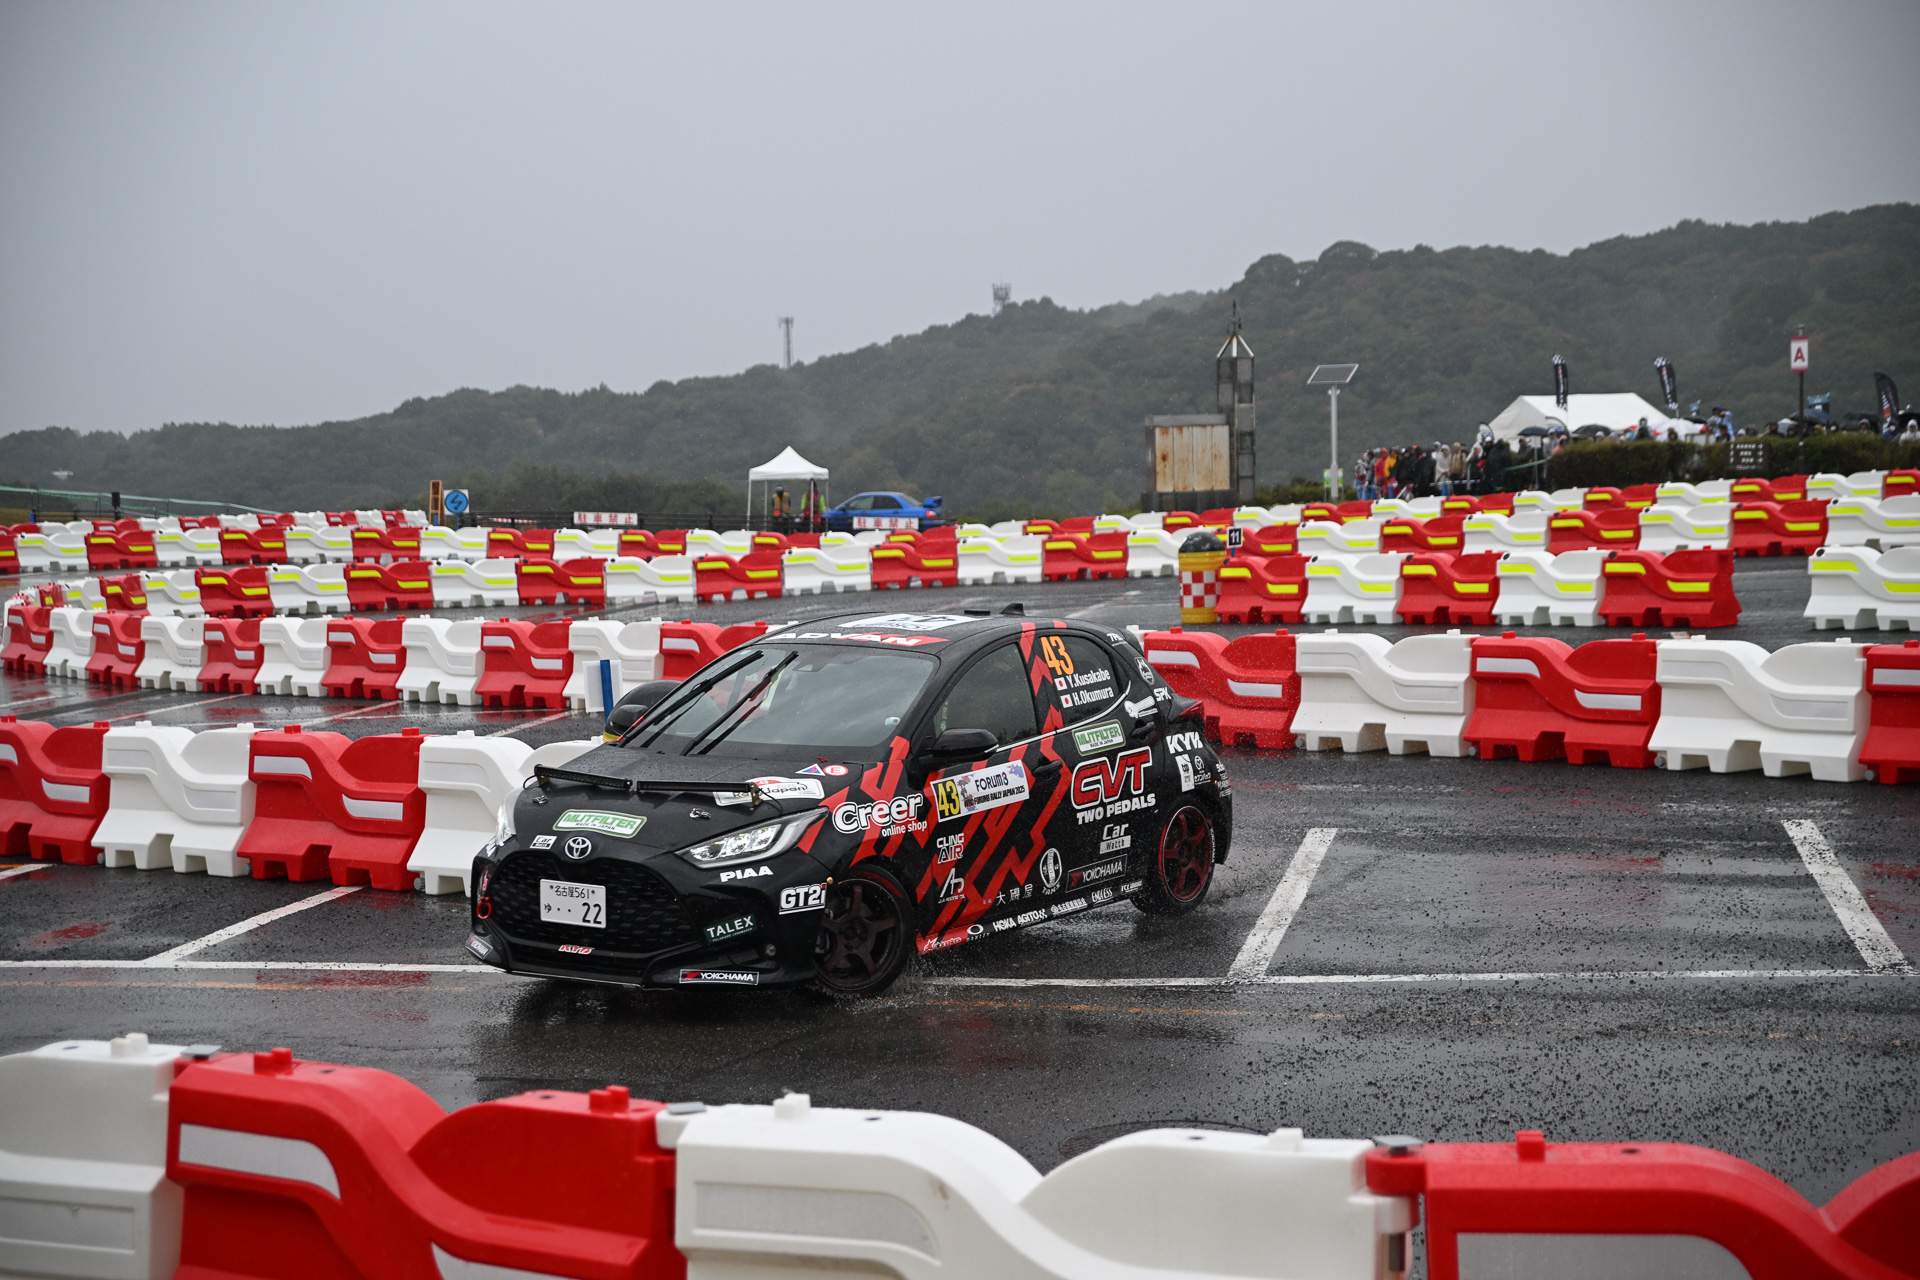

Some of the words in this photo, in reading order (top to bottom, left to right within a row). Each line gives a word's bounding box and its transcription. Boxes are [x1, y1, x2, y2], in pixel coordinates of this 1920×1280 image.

[1793, 346, 1806, 363] A
[577, 512, 635, 525] 駐車禁止
[856, 517, 915, 529] 駐車禁止
[1229, 531, 1240, 543] 11
[766, 632, 922, 646] ADVAN
[1041, 635, 1075, 676] 43
[1066, 668, 1111, 688] Y.Kusakabe
[1072, 687, 1114, 706] H.Okumura
[1153, 687, 1172, 702] SPK
[1077, 726, 1121, 745] MLITFILTER
[829, 766, 842, 775] E
[1071, 746, 1152, 809] CVT
[975, 772, 1009, 792] FORUM8
[1015, 785, 1026, 795] 2025
[938, 781, 960, 817] 43
[832, 794, 923, 834] Creer
[1076, 805, 1104, 825] TWO
[1106, 793, 1156, 818] PEDALS
[563, 813, 637, 829] MLITFILTER
[882, 823, 906, 838] online
[907, 820, 928, 835] shop
[1102, 823, 1129, 840] Car
[936, 833, 964, 848] CLING
[1106, 837, 1125, 850] Watch
[937, 844, 964, 864] AIR
[719, 865, 774, 882] PIAA
[1082, 861, 1123, 882] YOKOHAMA
[780, 883, 827, 909] GT2i
[1091, 887, 1113, 902] ENDLESS
[706, 915, 754, 938] TALEX
[993, 917, 1016, 932] HOKA
[700, 971, 754, 982] YOKOHAMA
